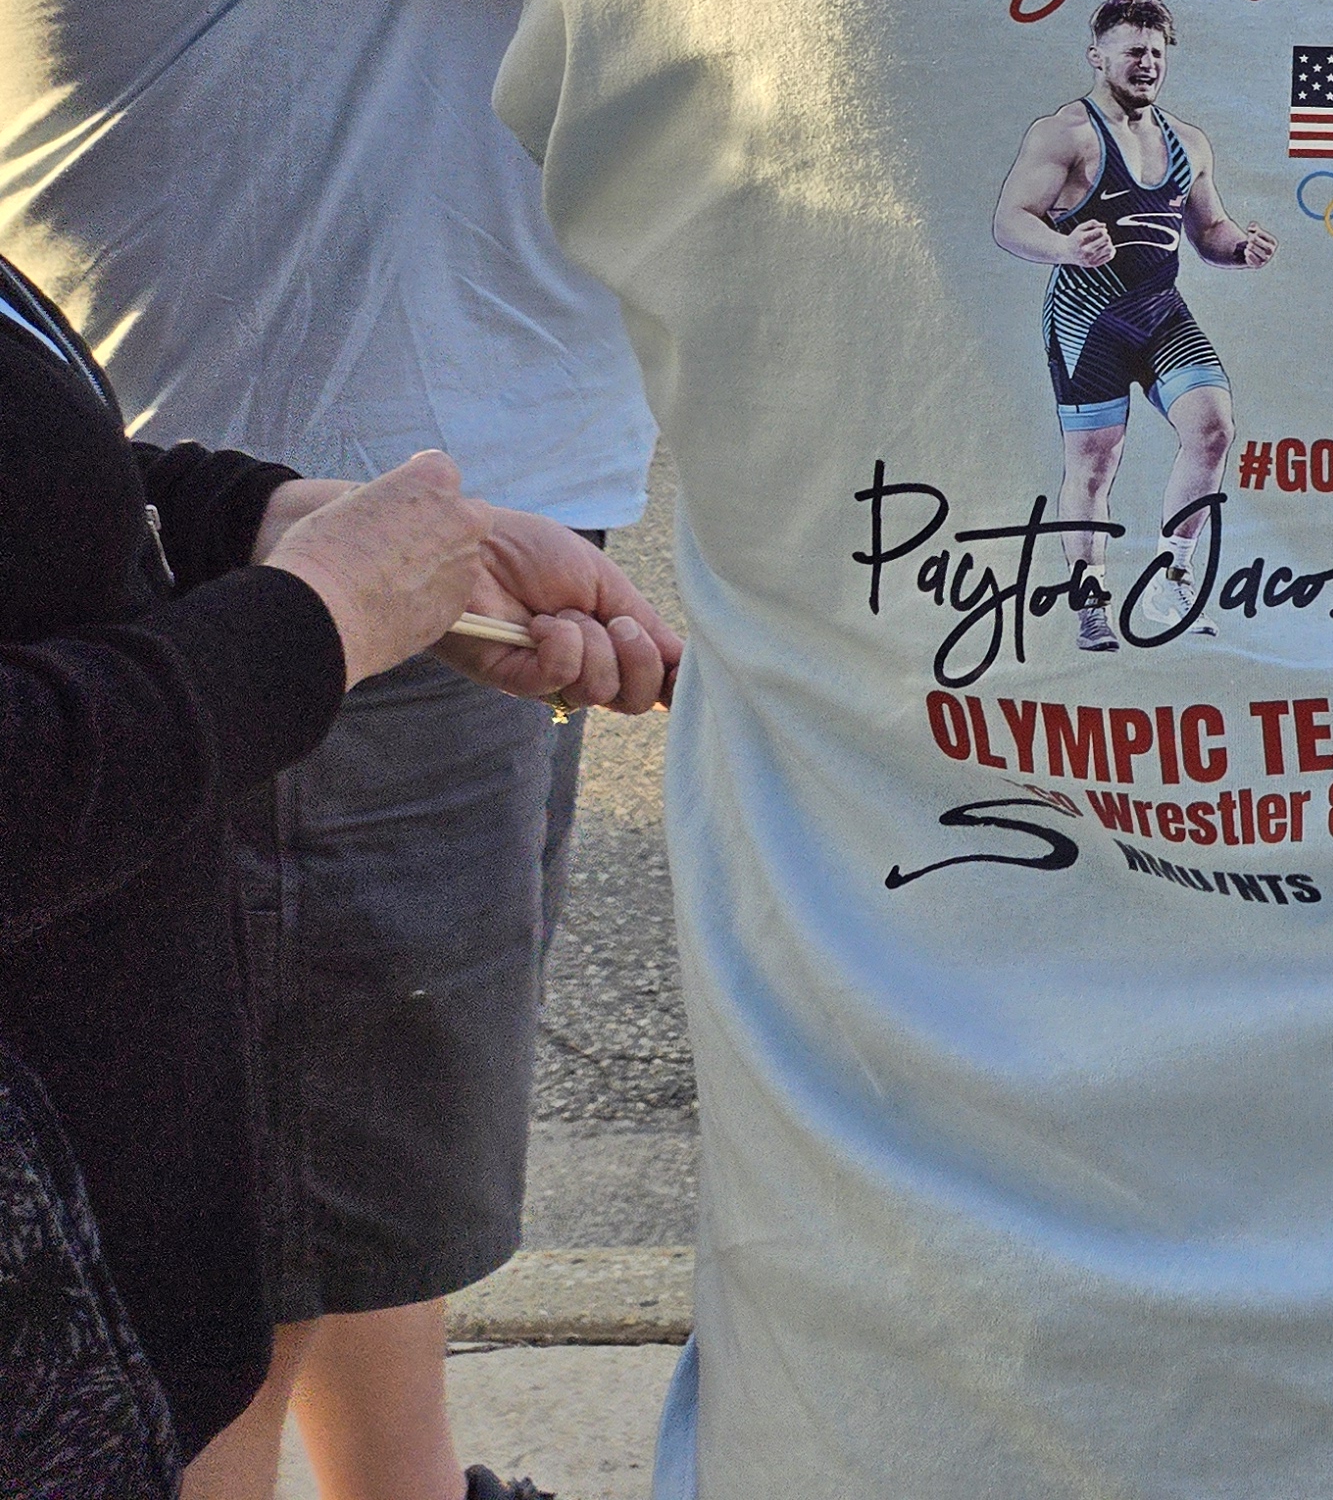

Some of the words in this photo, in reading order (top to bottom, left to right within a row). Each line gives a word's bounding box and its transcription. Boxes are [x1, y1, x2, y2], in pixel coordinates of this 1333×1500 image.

[851, 459, 1126, 689] Payton
[925, 690, 1228, 785] OLYMPIC
[1086, 789, 1311, 846] Wrestler
